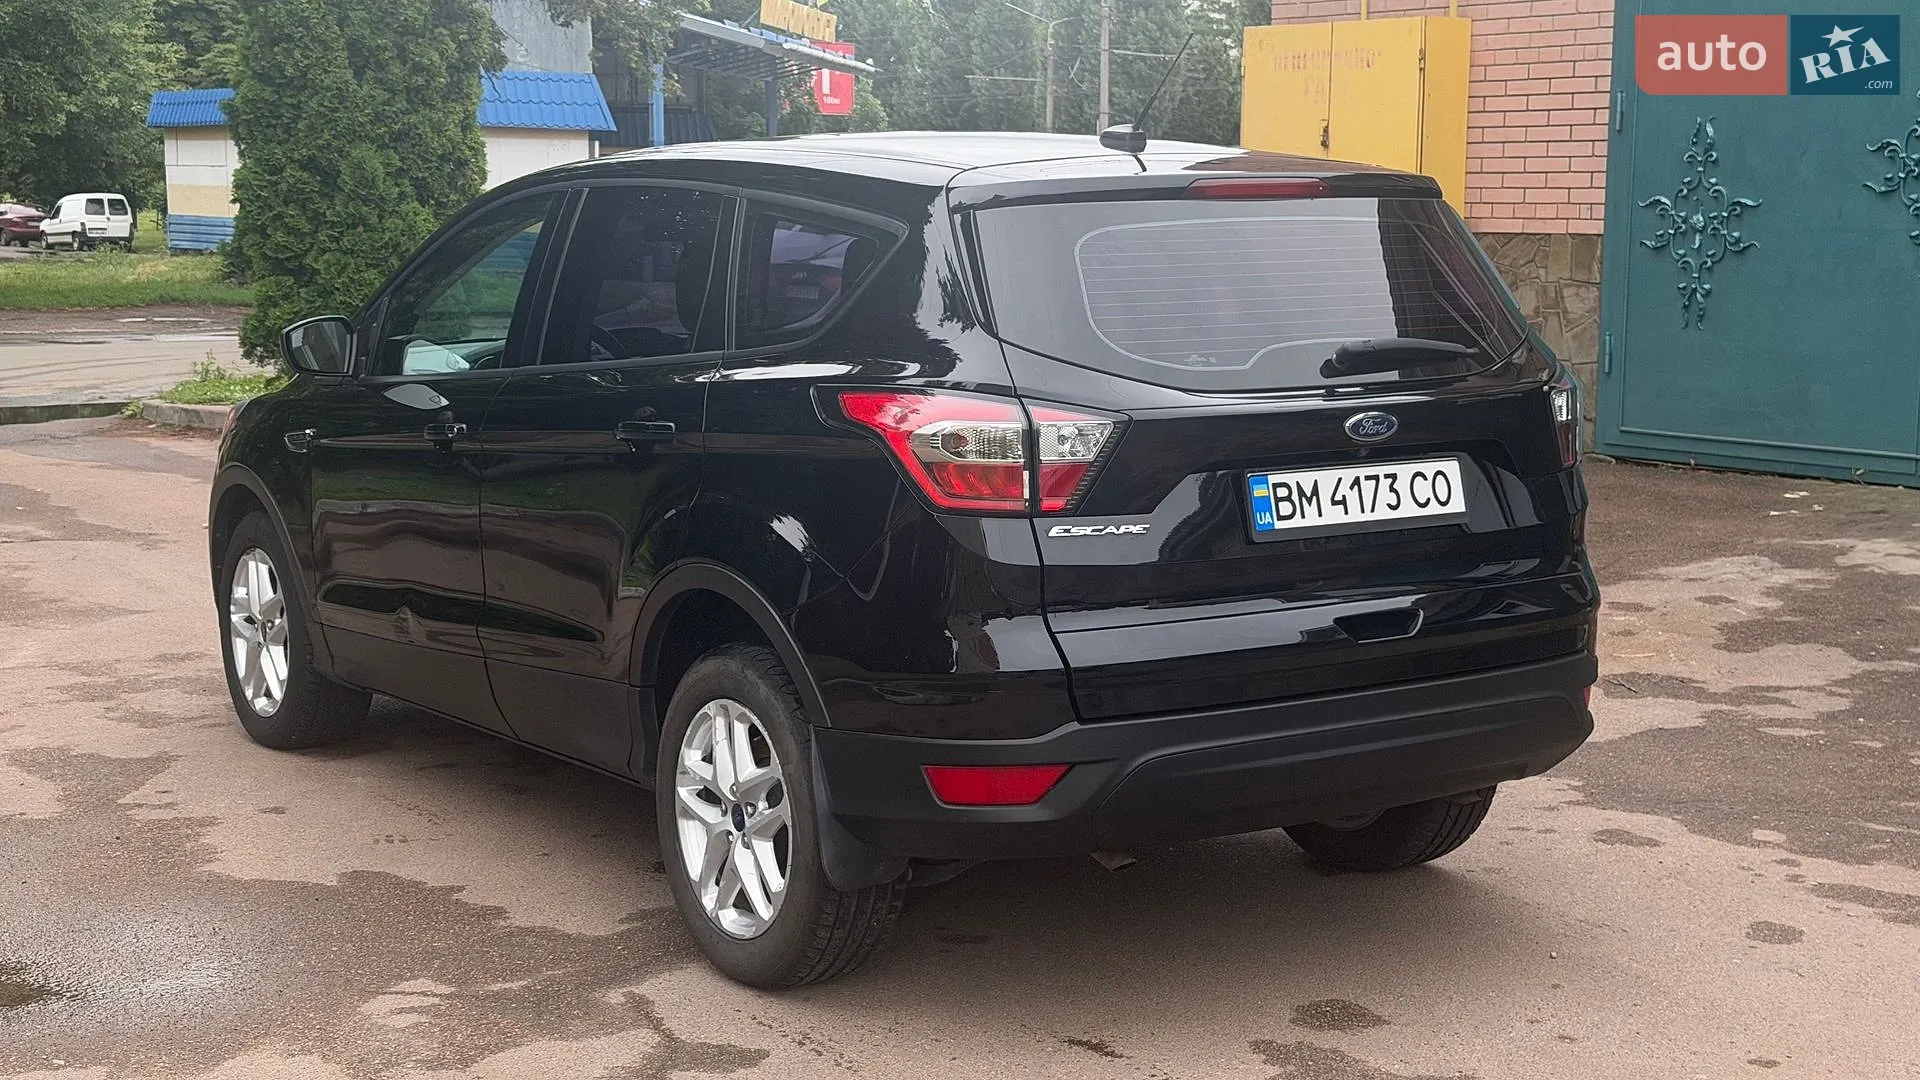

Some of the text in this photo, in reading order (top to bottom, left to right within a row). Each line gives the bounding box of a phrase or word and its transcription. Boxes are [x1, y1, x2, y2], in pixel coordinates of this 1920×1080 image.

[1358, 418, 1388, 435] Ford
[1272, 469, 1452, 522] BM 4173 CO
[1257, 511, 1273, 525] UA
[1048, 524, 1150, 537] ESCAPE
